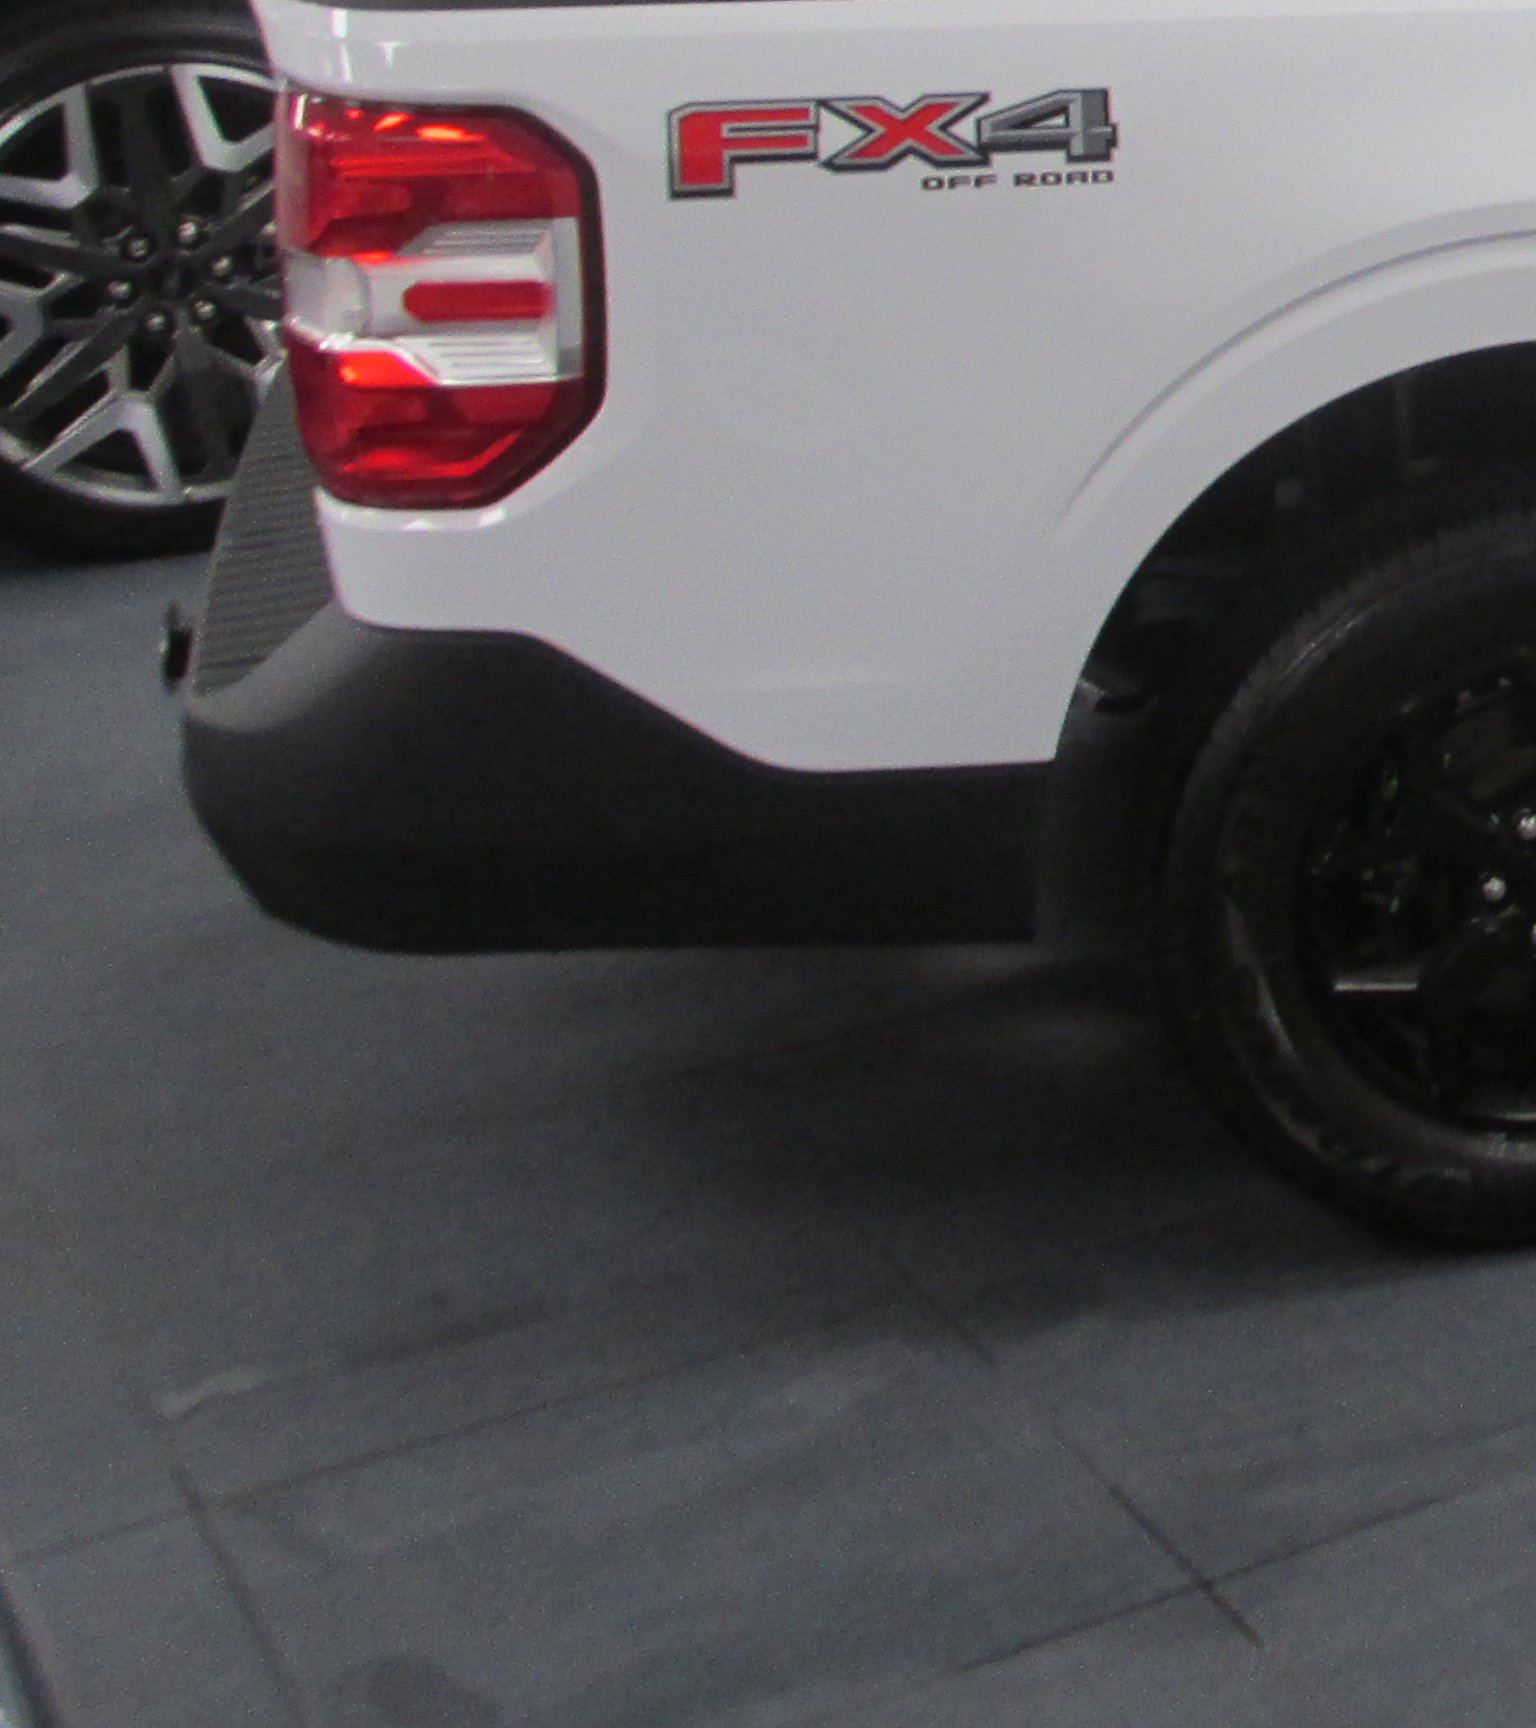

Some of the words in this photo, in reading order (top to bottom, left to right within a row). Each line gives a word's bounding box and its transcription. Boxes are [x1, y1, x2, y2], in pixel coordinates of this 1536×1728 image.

[667, 86, 1118, 200] FX4
[920, 173, 998, 191] OFF
[1013, 170, 1115, 187] ROAD
